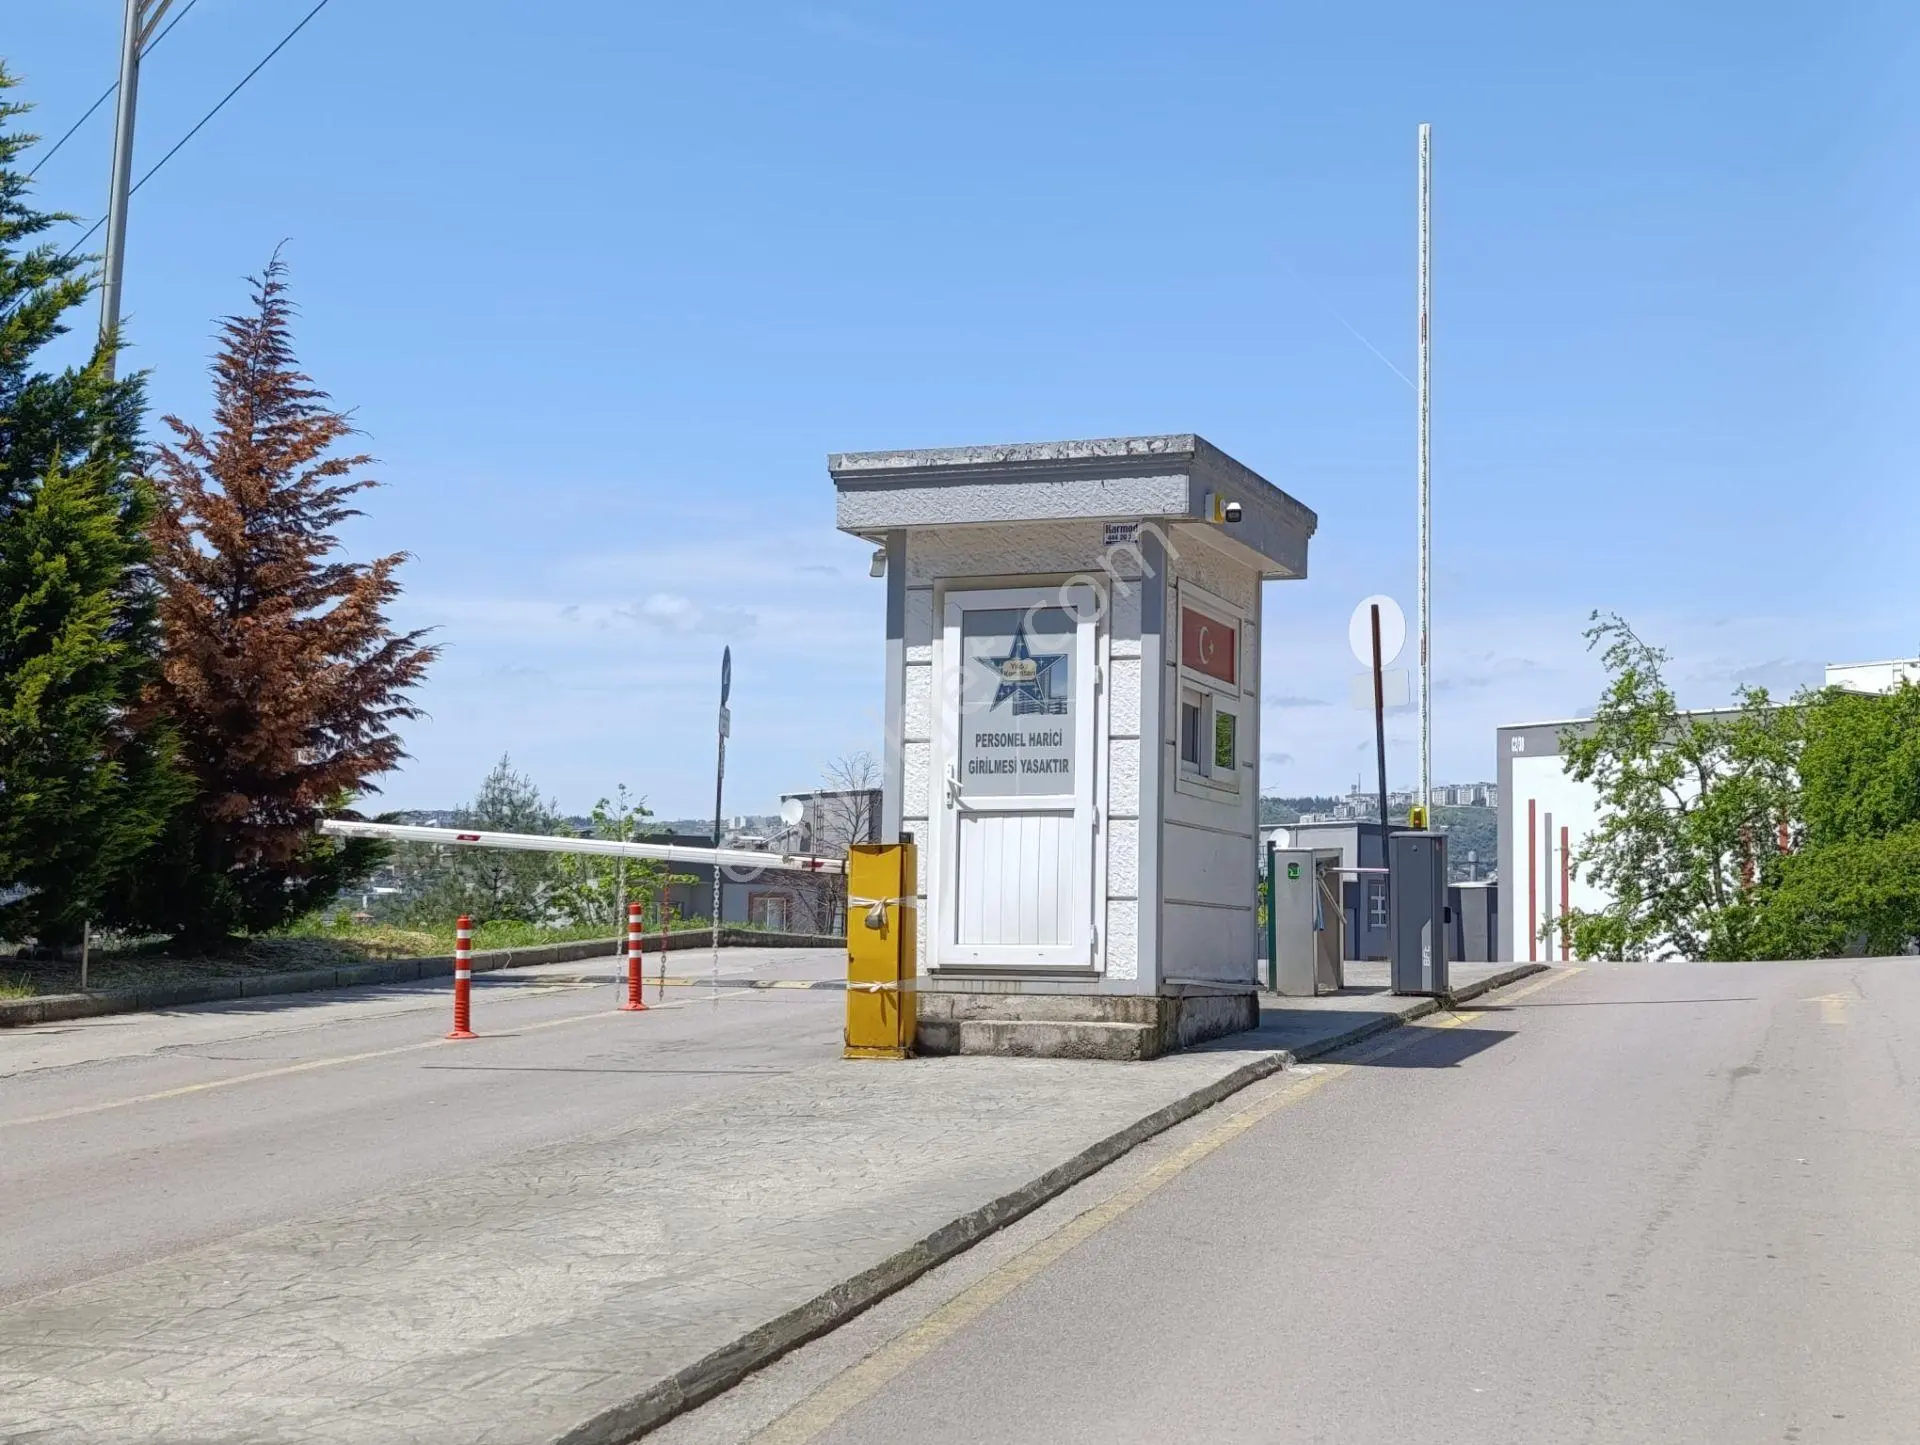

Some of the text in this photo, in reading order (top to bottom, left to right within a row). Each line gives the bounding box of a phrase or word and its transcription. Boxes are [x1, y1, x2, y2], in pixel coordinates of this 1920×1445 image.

[975, 728, 1063, 748] PERSONEL HARİCİ
[968, 756, 1069, 774] GİRİLMESİ YASAKTIR
